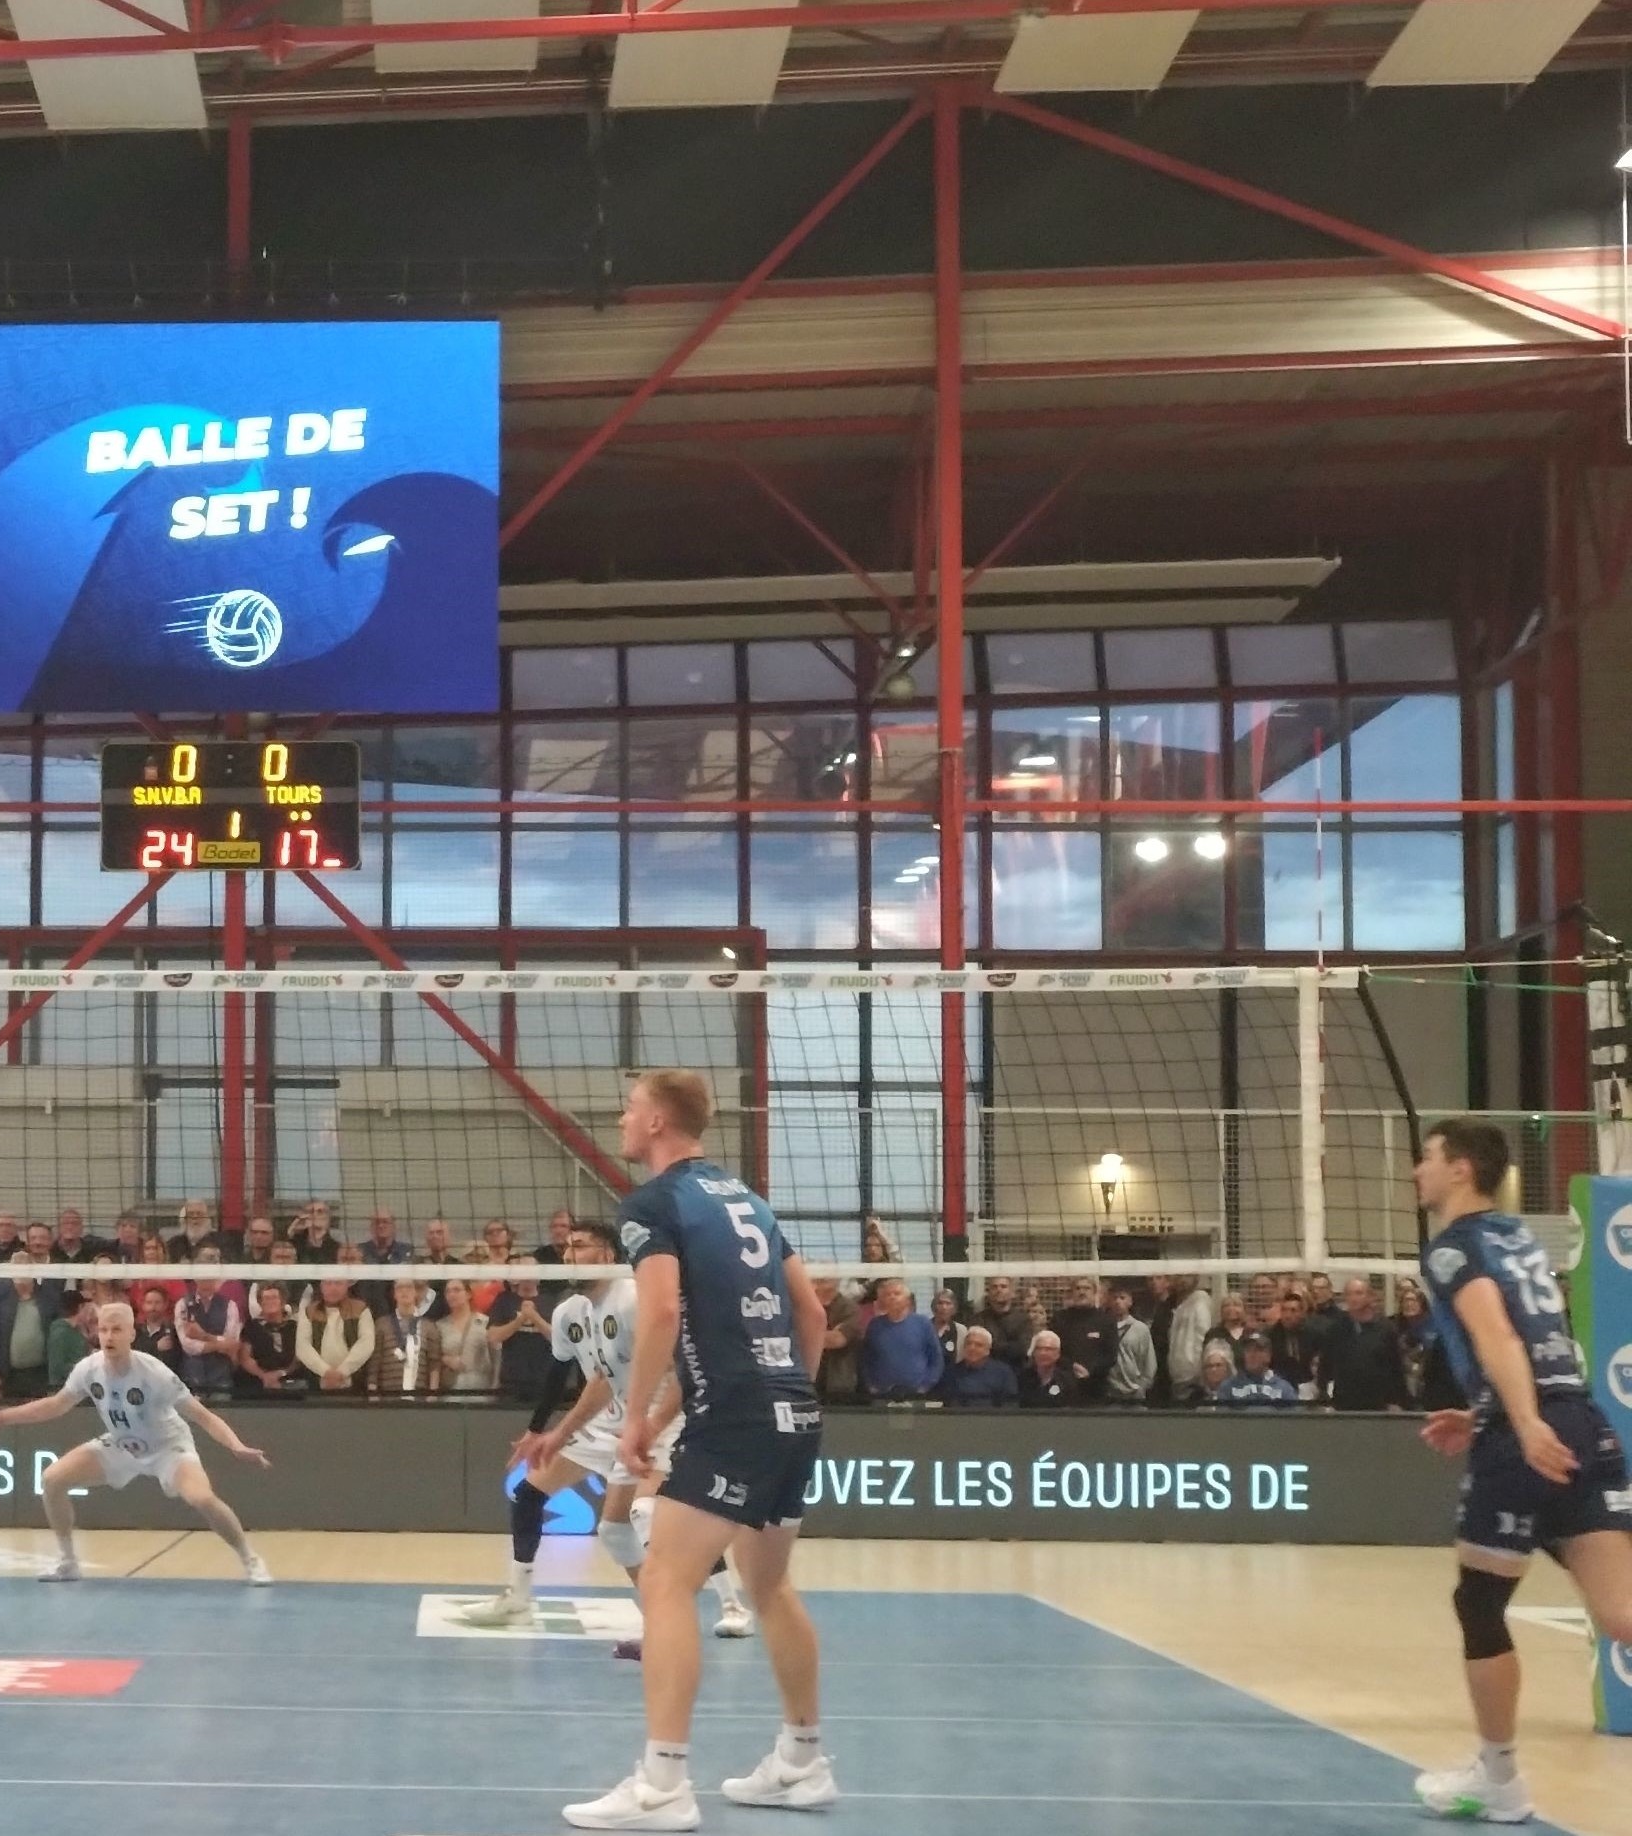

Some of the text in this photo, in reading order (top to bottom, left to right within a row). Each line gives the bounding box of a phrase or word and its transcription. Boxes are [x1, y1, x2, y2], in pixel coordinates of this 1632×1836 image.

[86, 407, 367, 474] BALLE DE
[169, 487, 311, 540] SET !
[172, 745, 197, 783] 0
[263, 744, 288, 781] 0
[266, 786, 322, 804] TOURS
[142, 830, 193, 867] 24
[12, 975, 60, 986] FRUIDIS
[282, 975, 330, 987] FRUIDIS
[830, 976, 879, 987] FRUIDIS
[1109, 974, 1159, 985] FRUIDIS
[725, 1203, 769, 1269] 5
[109, 1408, 131, 1430] 14
[35, 1450, 89, 1496] D
[934, 1461, 1013, 1508] LES
[1031, 1450, 1231, 1511] ÉQUIPES
[1250, 1464, 1309, 1511] DE
